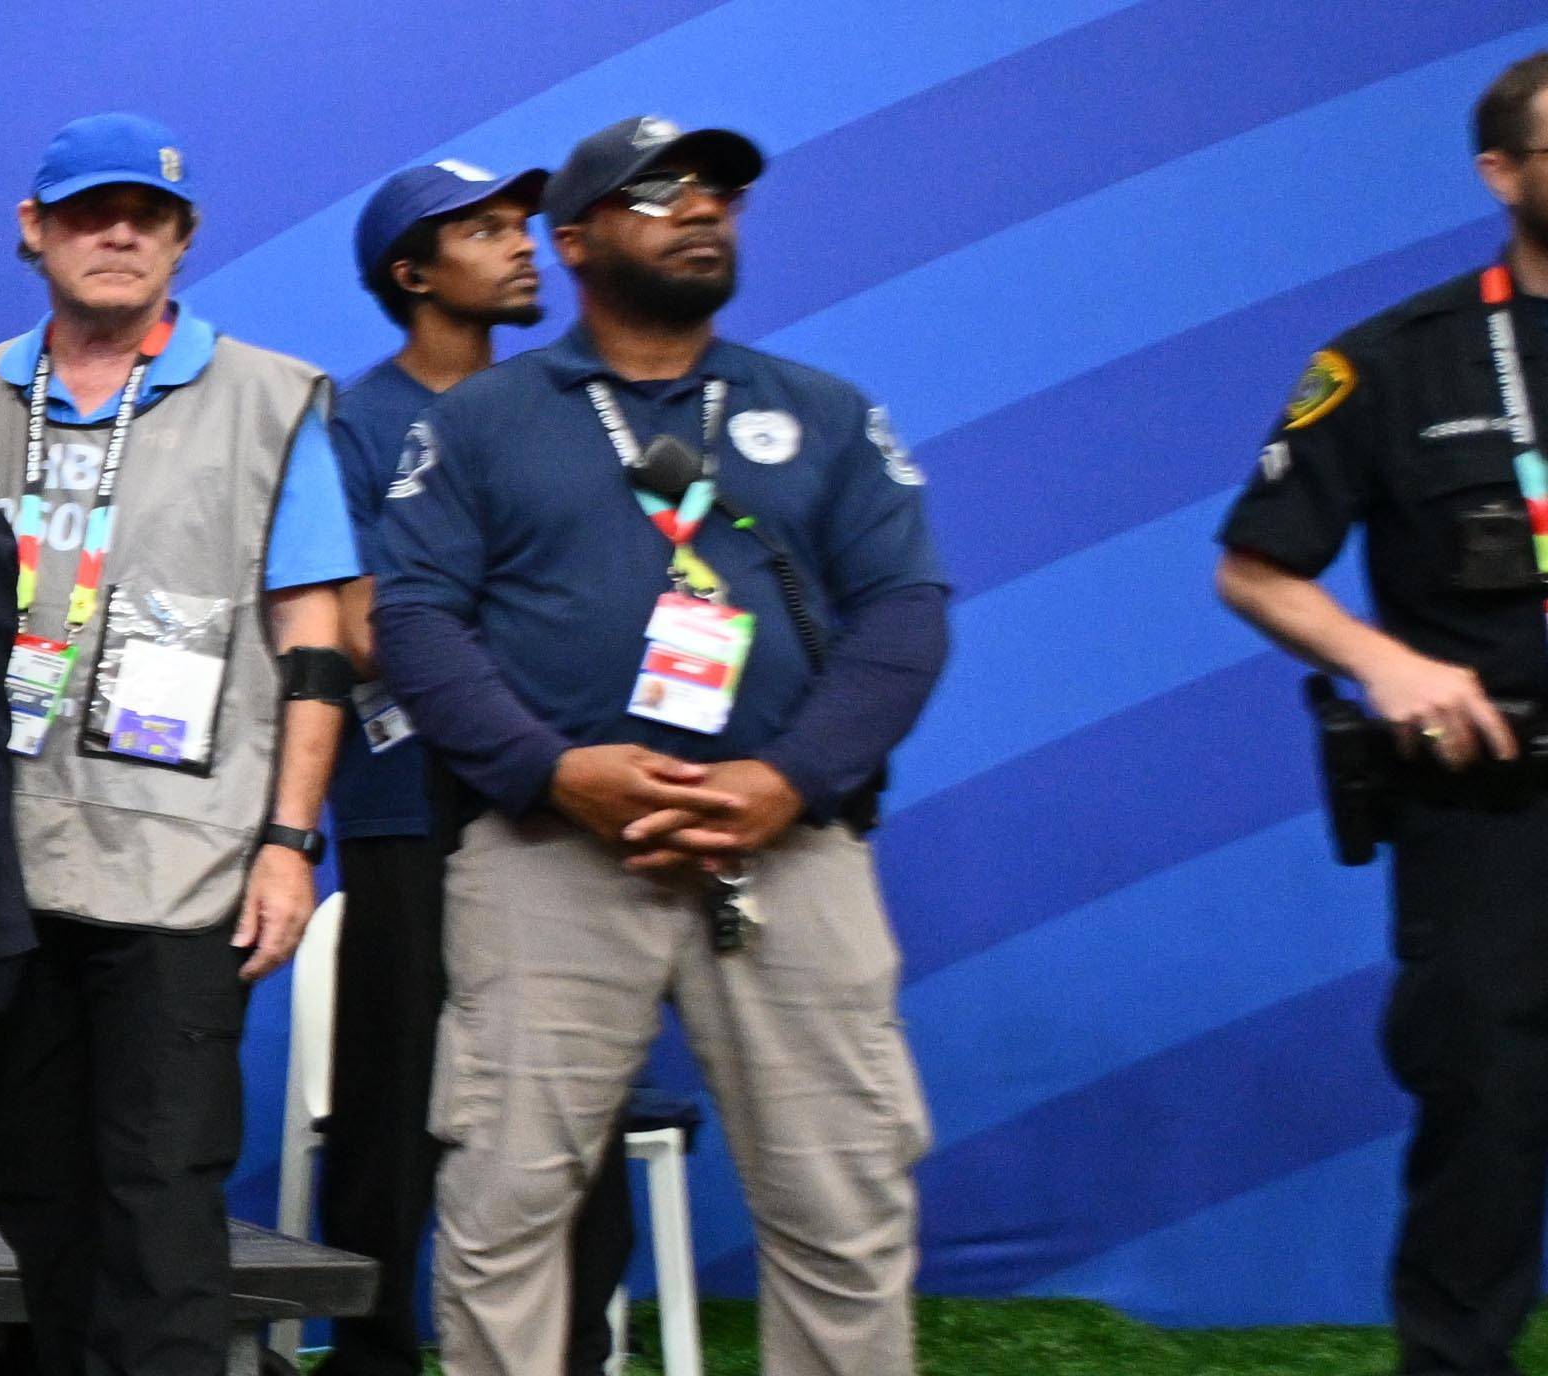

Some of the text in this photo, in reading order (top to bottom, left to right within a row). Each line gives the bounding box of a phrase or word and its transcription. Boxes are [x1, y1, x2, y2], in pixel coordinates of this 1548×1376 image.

[31, 375, 48, 417] WORLD
[29, 415, 44, 440] CUP
[105, 429, 126, 470] WORLD
[98, 467, 117, 495] FIFA
